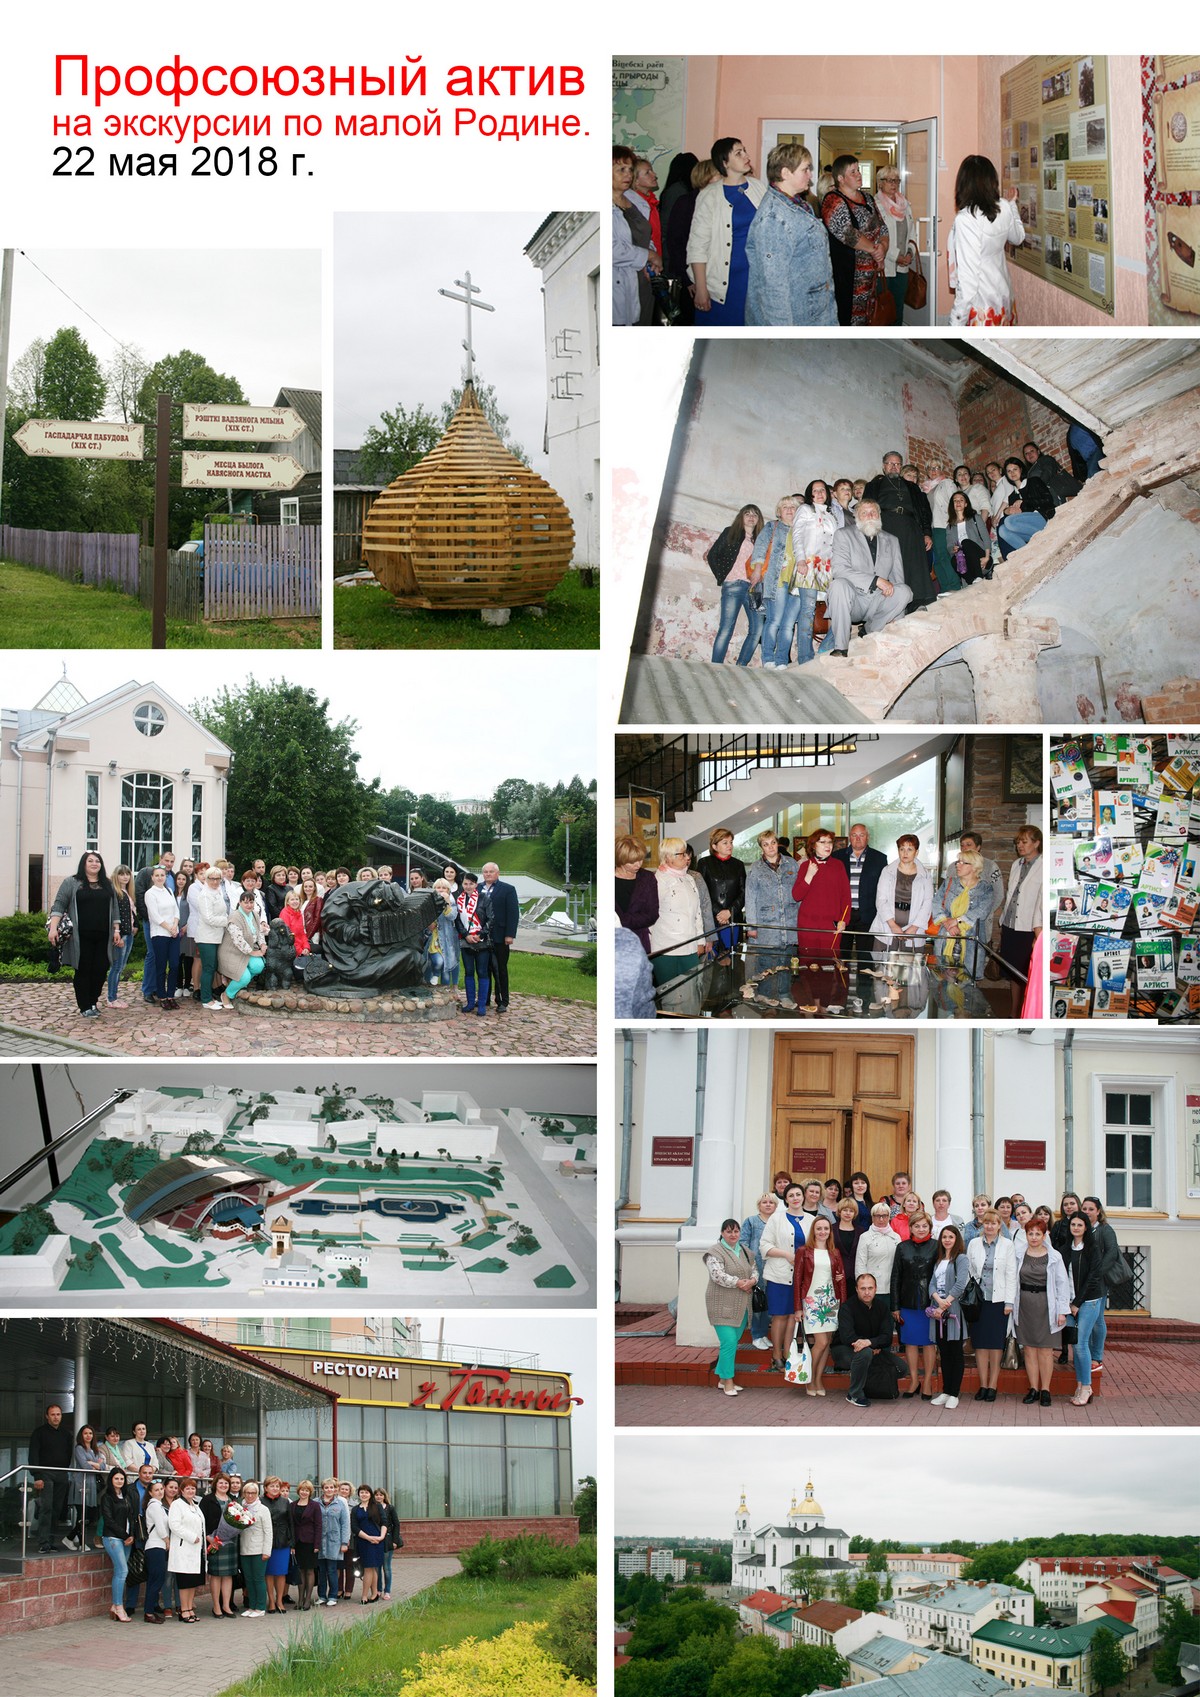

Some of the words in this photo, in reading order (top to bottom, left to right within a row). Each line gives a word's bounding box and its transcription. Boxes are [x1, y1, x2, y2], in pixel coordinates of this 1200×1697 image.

[221, 416, 258, 424] ВАДЗЯНОГА
[260, 417, 284, 425] МЛЫНА
[241, 425, 255, 433] СТ.)
[44, 431, 92, 440] ГАСПАДАРЧАЯ
[94, 433, 129, 442] ПАБУДОВА
[88, 442, 102, 450] СТ.)
[214, 461, 236, 469] МЕСЦА
[312, 1361, 399, 1380] РЕСТОРАН
